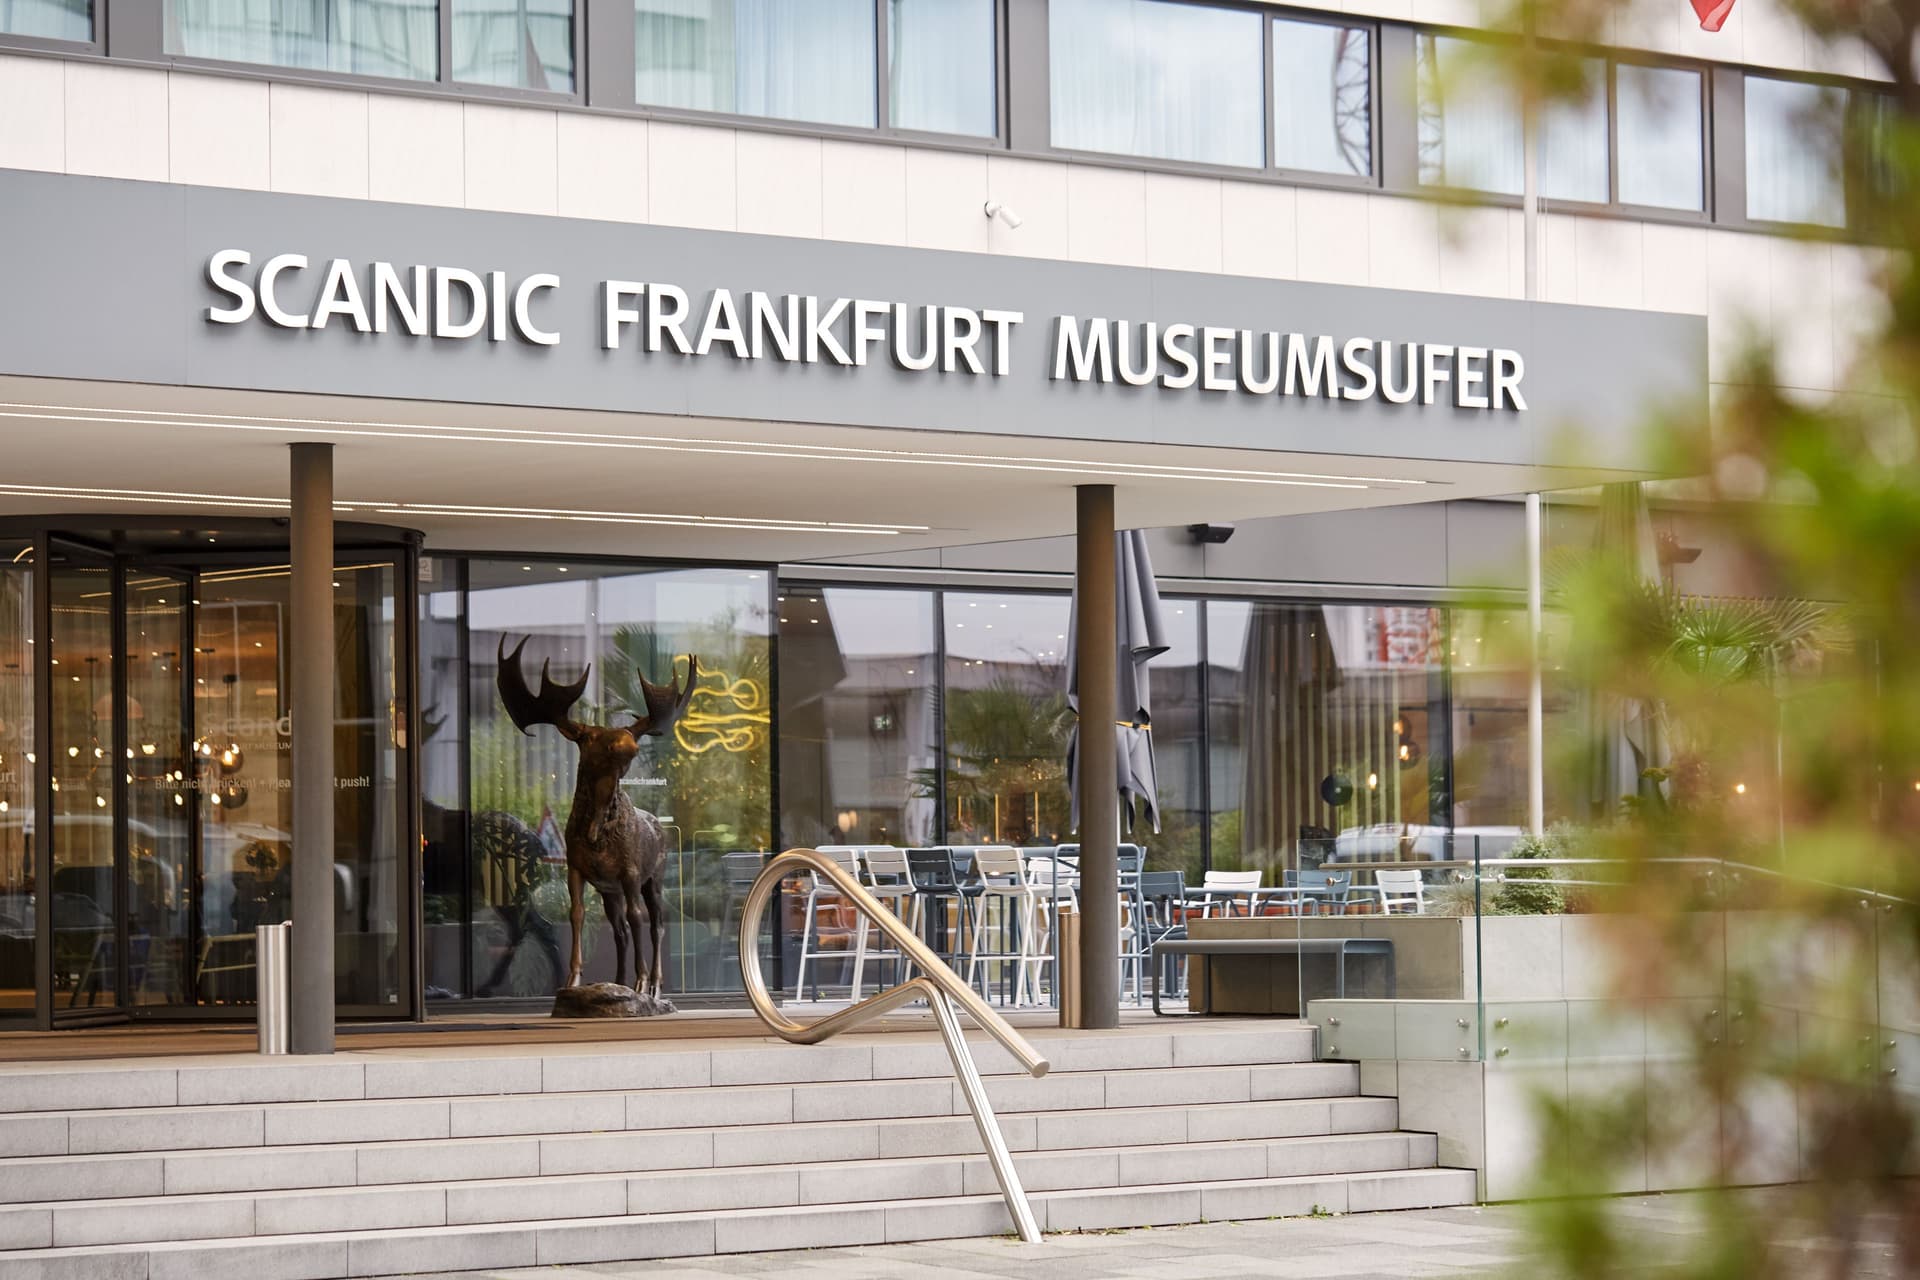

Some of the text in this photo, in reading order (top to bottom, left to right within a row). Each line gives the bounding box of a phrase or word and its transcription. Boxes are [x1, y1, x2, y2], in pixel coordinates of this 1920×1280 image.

[206, 249, 1528, 411] SCANDIC FRANKFURT MUSEUMSUFER
[202, 710, 291, 736] Scand
[340, 776, 370, 789] push!
